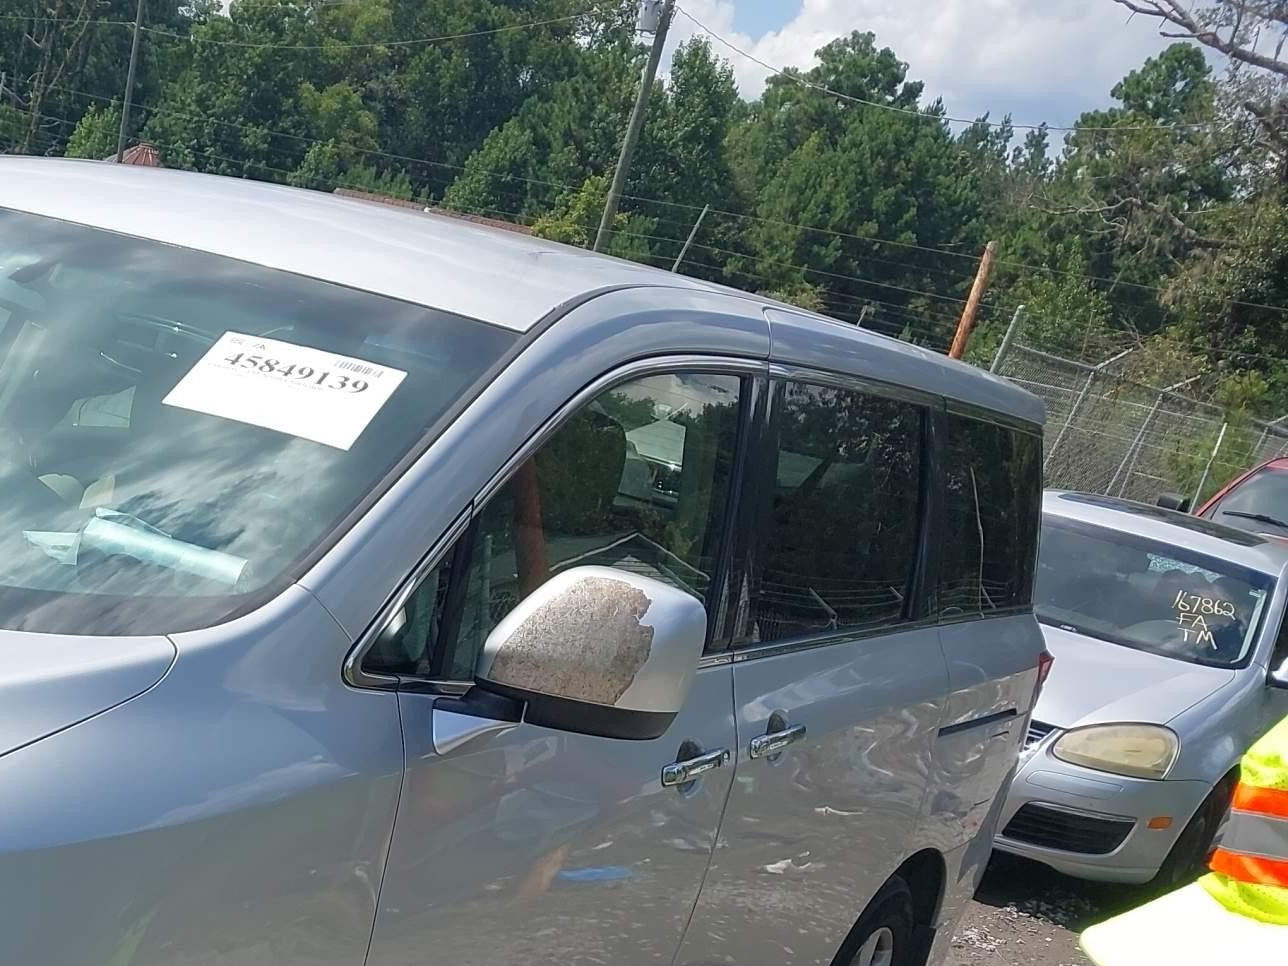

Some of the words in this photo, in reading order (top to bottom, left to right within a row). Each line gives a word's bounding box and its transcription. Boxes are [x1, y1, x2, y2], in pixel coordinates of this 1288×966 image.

[224, 352, 369, 394] 45849139
[1172, 589, 1236, 621] 167862
[1176, 612, 1208, 632] FA
[1177, 627, 1218, 650] TM
